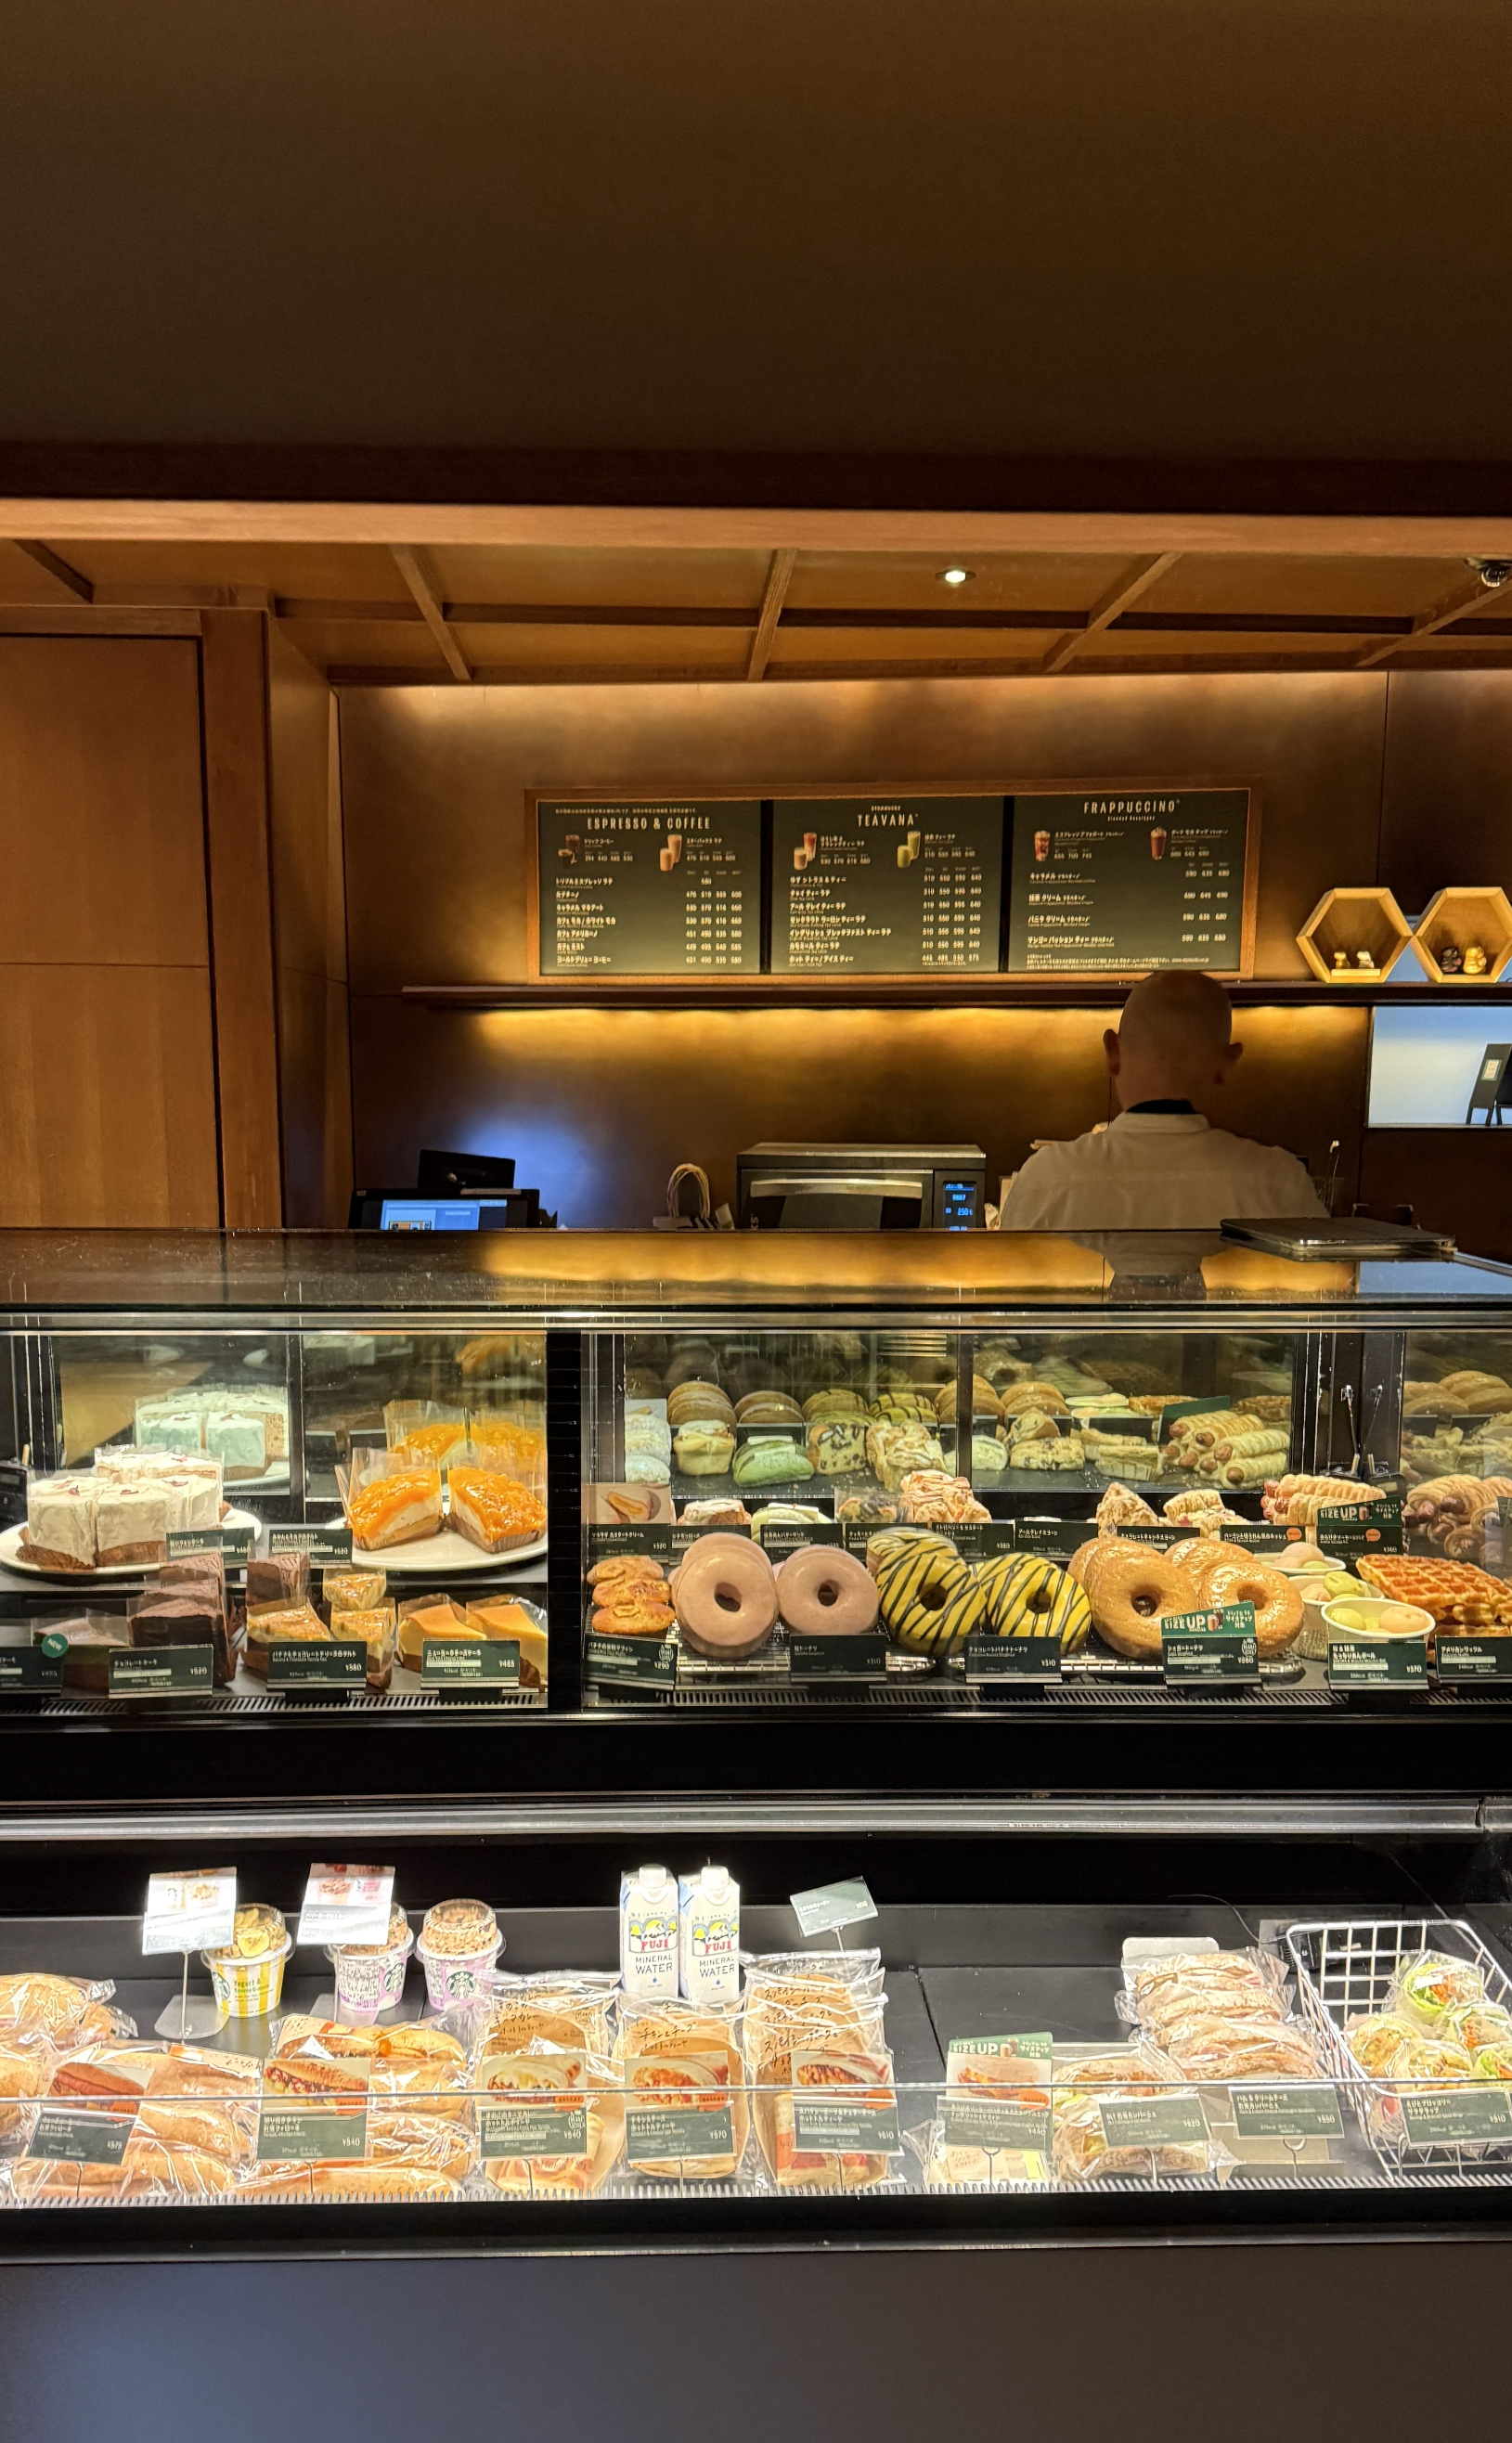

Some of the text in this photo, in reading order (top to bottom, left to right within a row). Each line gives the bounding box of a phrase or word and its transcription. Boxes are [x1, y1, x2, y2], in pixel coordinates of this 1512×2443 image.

[1084, 800, 1176, 814] FRAPPUCCINO
[587, 817, 710, 830] ESPRESSO & COFFEE
[858, 814, 914, 827] TEAVANA
[1320, 1507, 1357, 1519] SIZE UP
[1186, 1614, 1206, 1629] UP
[641, 1938, 668, 1951] FUJI
[705, 1940, 731, 1954] FUJI
[636, 1954, 672, 1963] MINERAL
[699, 1957, 734, 1967] MINERAL
[636, 1962, 673, 1975] WATER
[699, 1964, 735, 1978] WATER
[233, 1978, 253, 1988] Yogurt
[953, 2043, 998, 2055] SIZE UP
